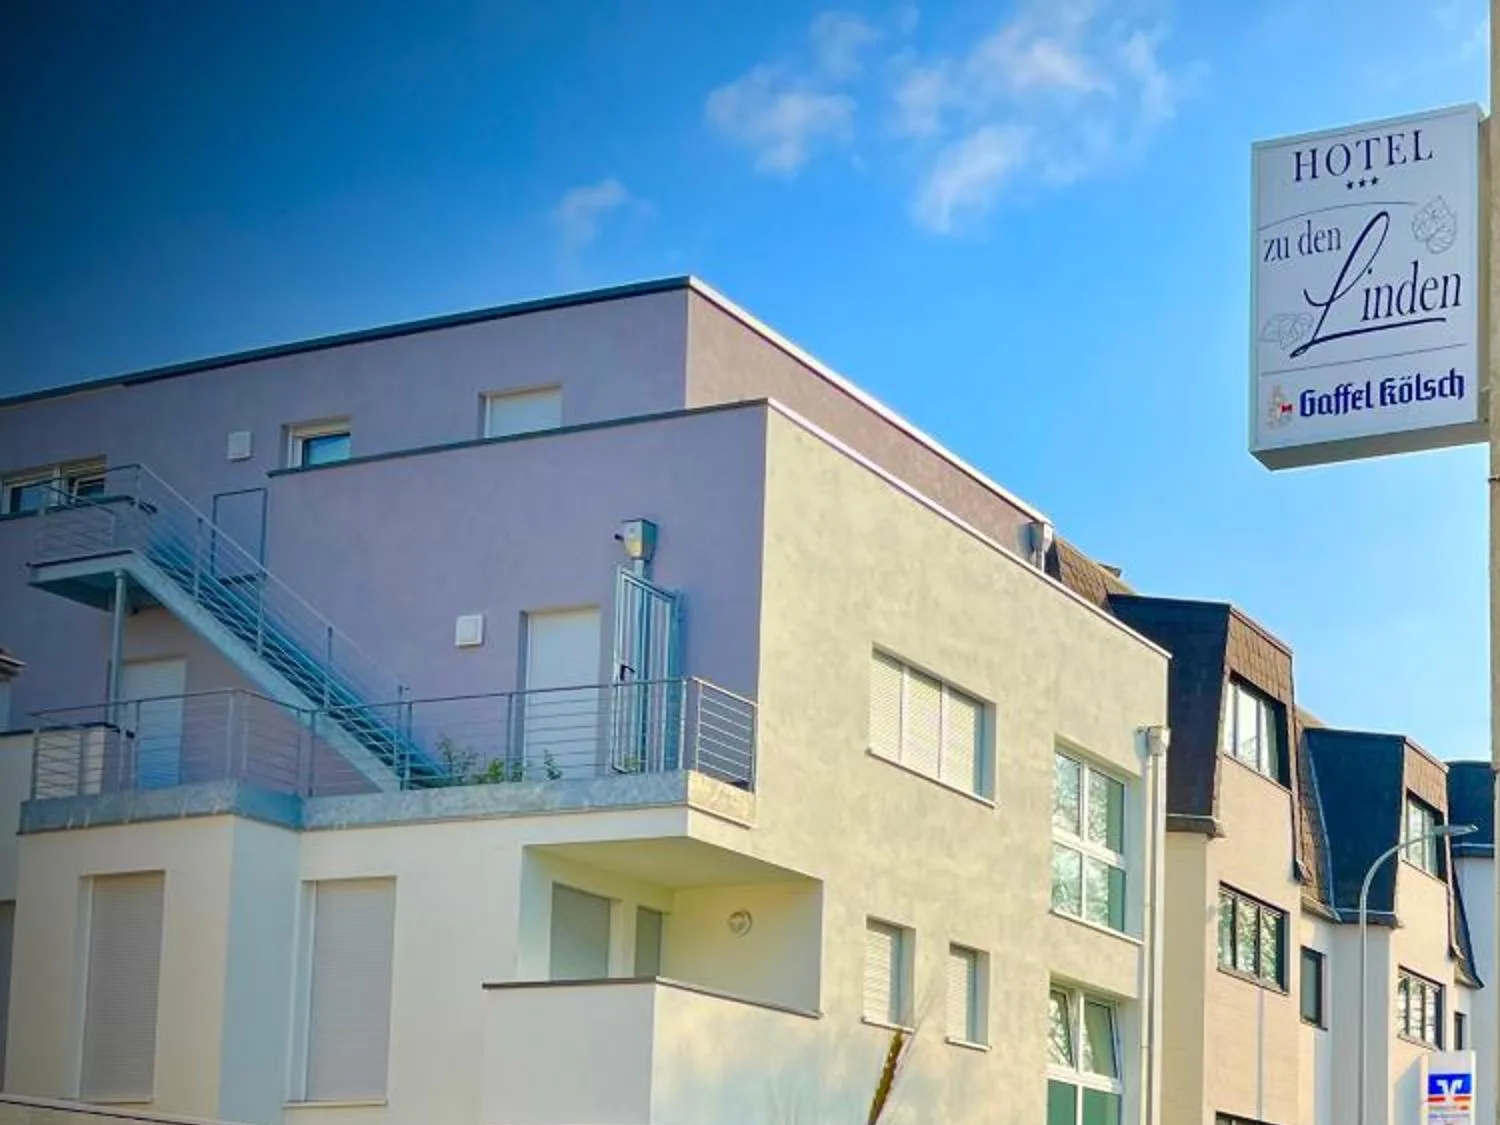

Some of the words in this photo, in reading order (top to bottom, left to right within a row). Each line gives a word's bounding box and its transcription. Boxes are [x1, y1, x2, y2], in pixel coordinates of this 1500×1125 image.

[1294, 129, 1433, 182] HOTEL
[1263, 235, 1289, 263] zu
[1297, 219, 1342, 257] den
[1290, 210, 1462, 359] Linden
[1299, 380, 1374, 417] Gaffel
[1379, 367, 1466, 407] Kölsch
